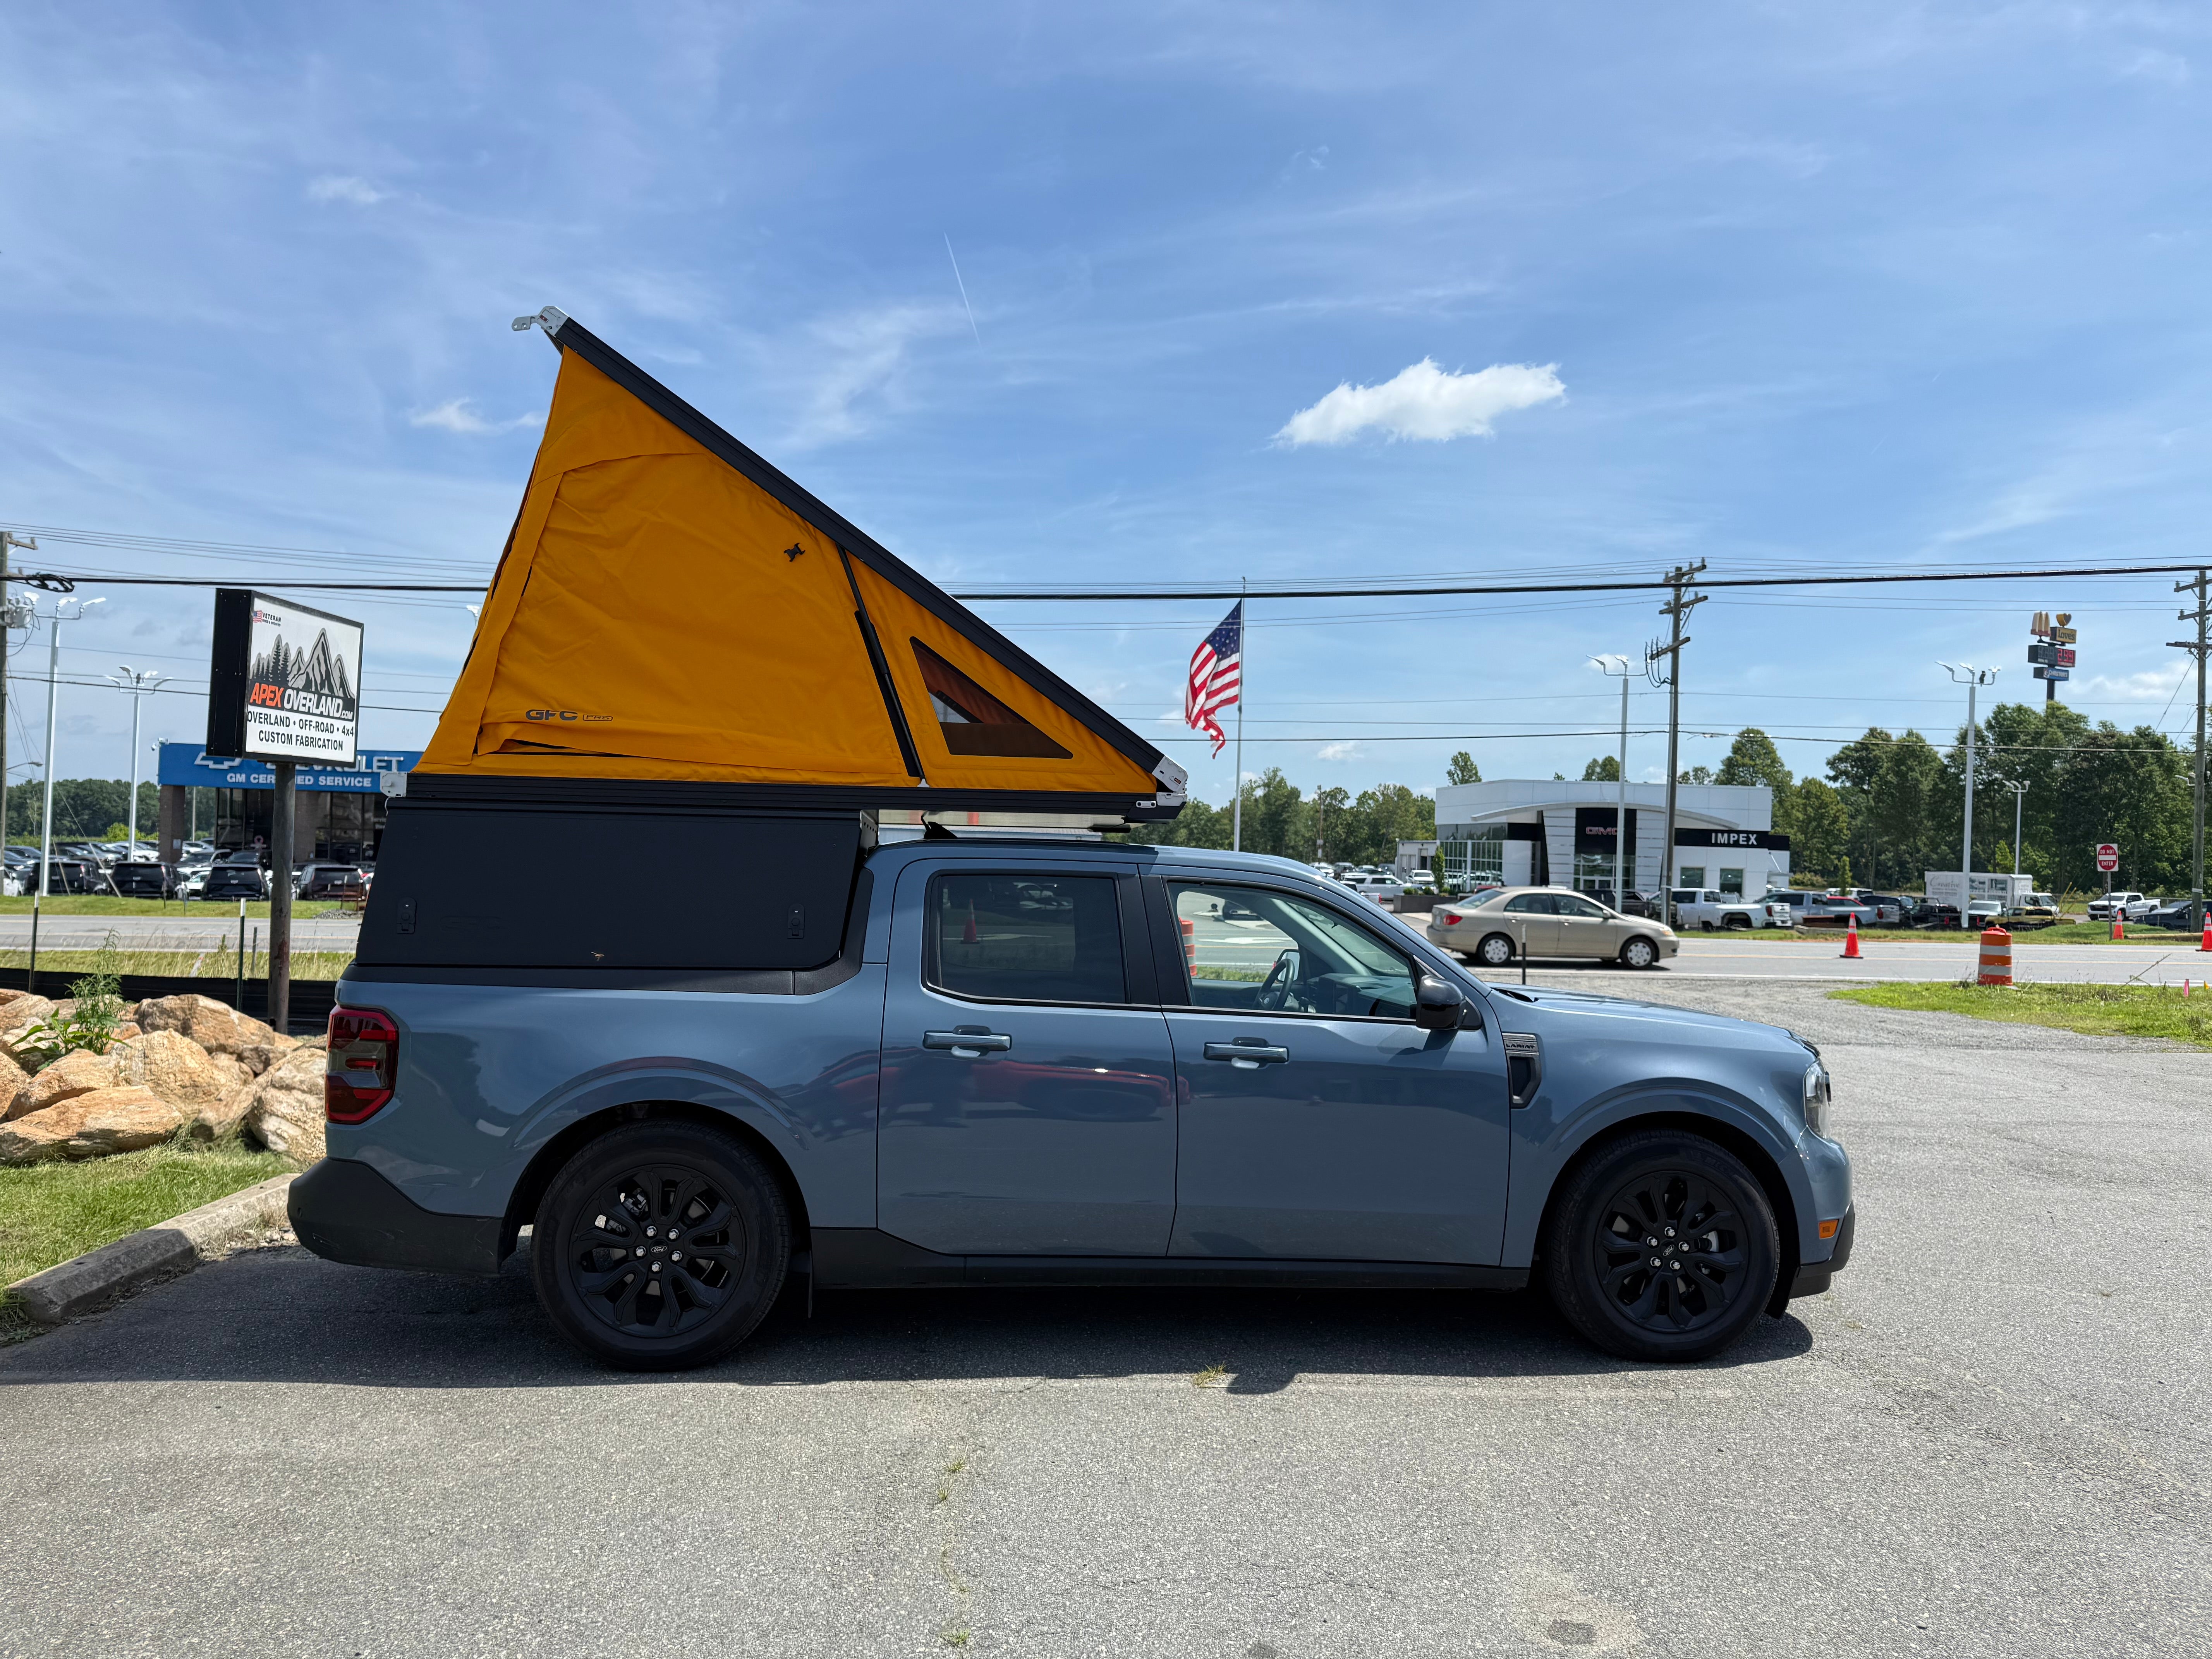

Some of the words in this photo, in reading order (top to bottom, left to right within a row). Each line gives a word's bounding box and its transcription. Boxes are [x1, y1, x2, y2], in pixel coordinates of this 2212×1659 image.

[263, 612, 281, 622] VETERAN
[2058, 629, 2075, 640] Love's
[250, 682, 284, 708] APEX
[526, 709, 578, 721] GFC
[247, 711, 290, 727] OVERLAND
[342, 725, 354, 737] 4x4
[259, 730, 293, 745] CUSTOM
[295, 735, 343, 751] FABRICATION
[227, 773, 246, 783] GM
[318, 776, 371, 787] SERVICE
[1712, 833, 1757, 845] IMPEX
